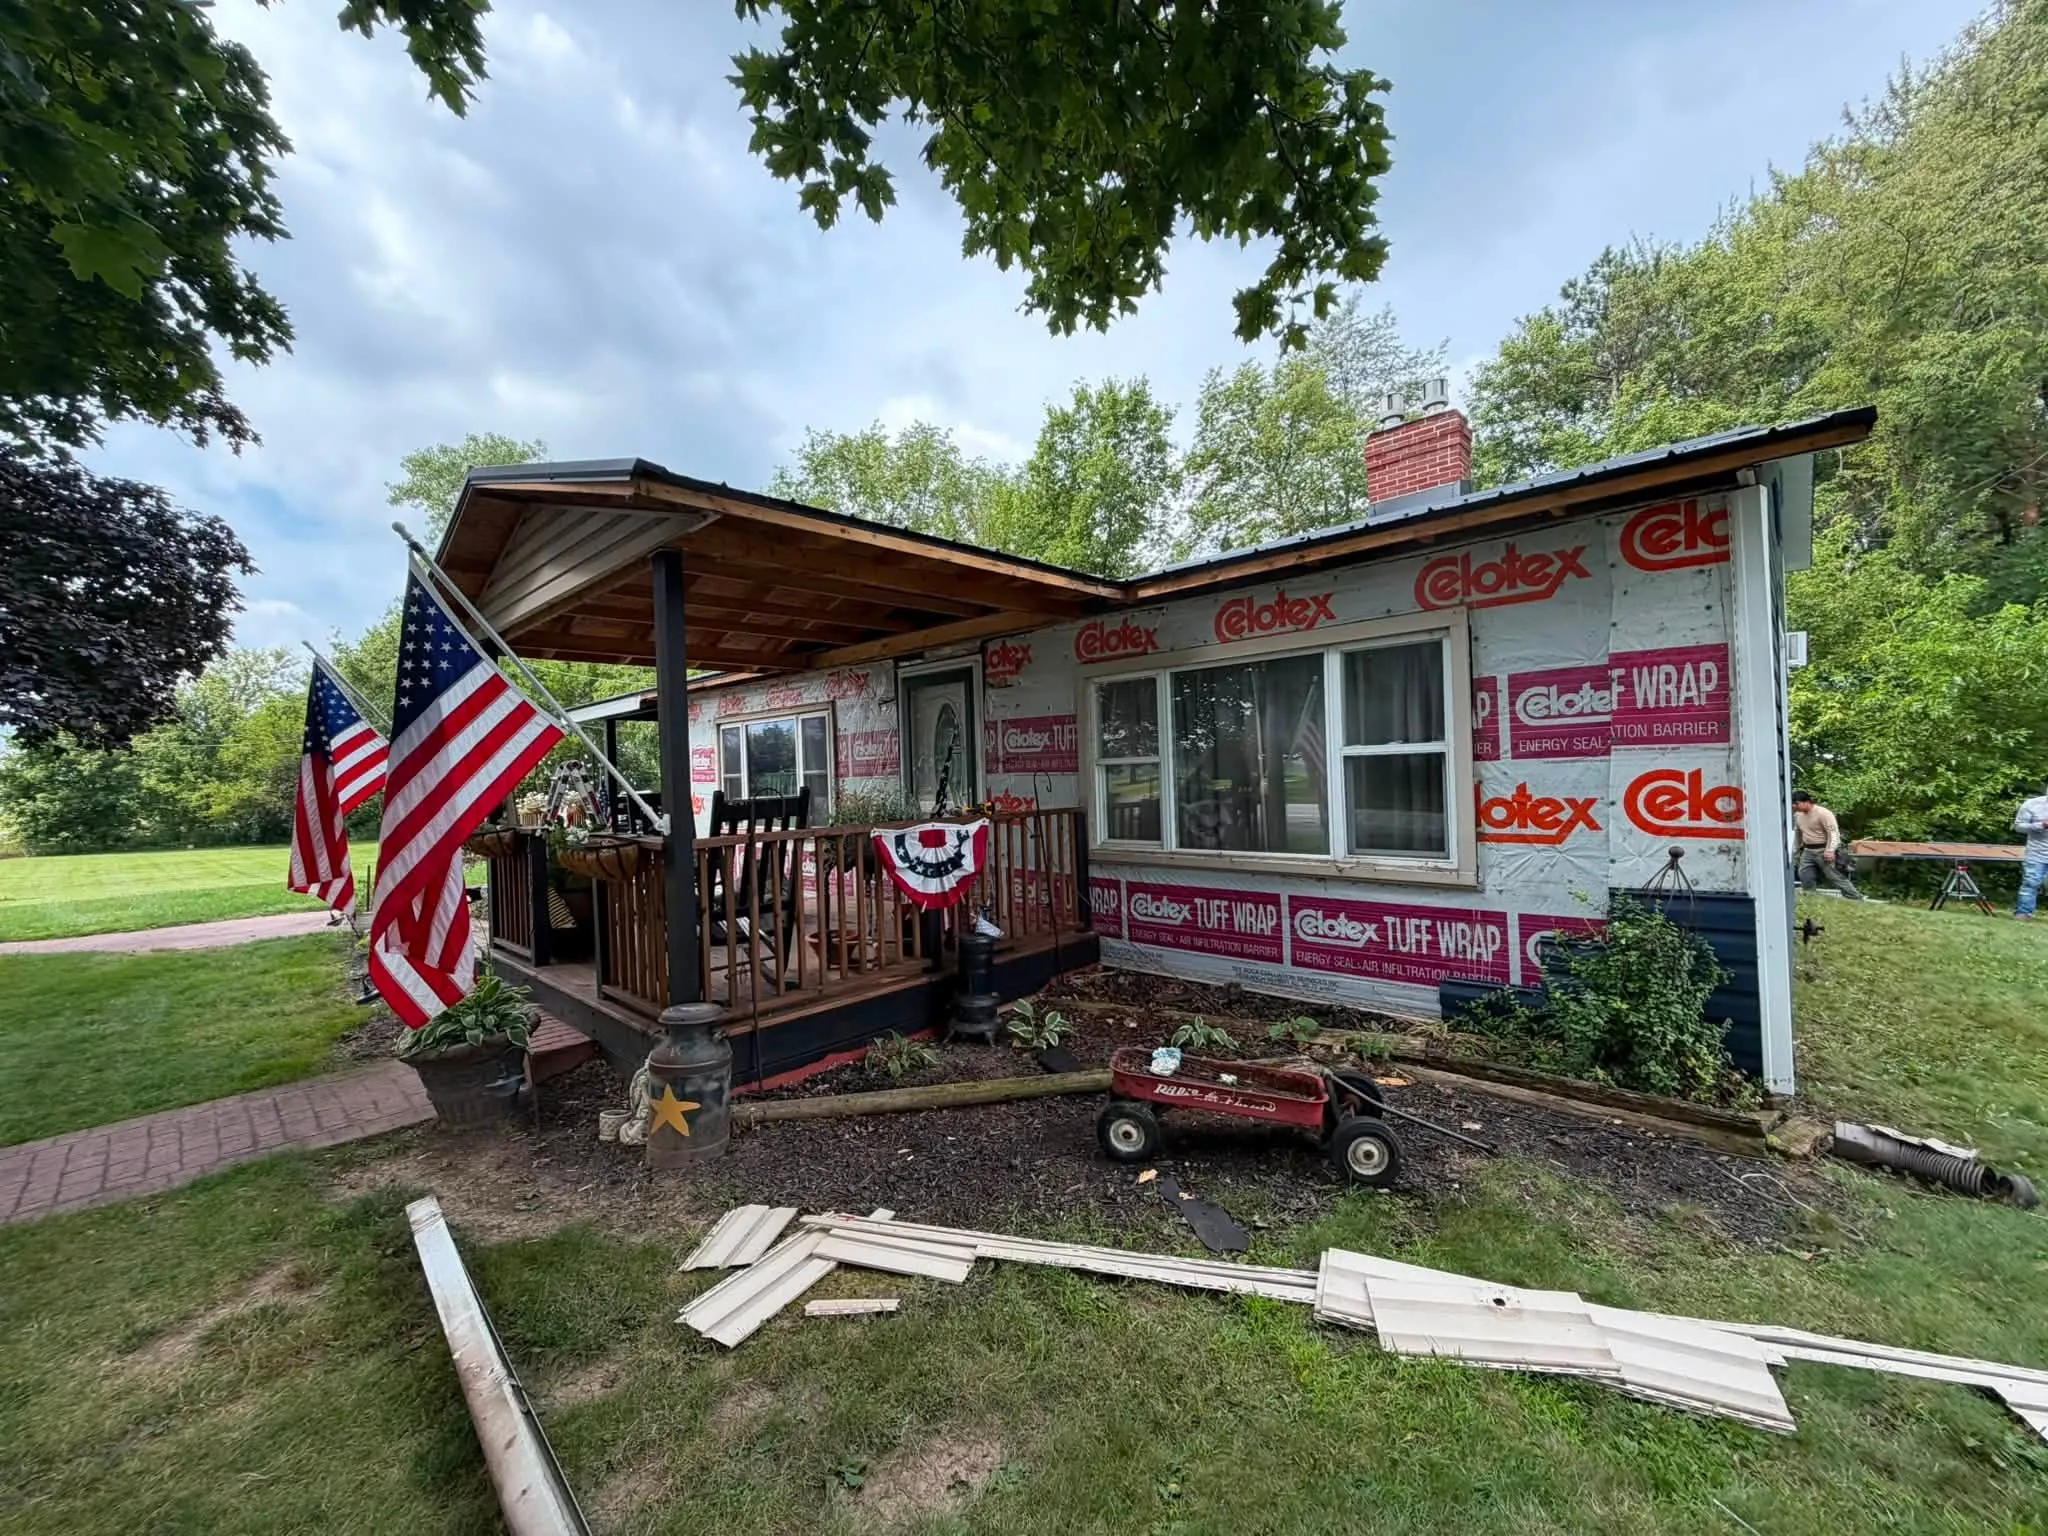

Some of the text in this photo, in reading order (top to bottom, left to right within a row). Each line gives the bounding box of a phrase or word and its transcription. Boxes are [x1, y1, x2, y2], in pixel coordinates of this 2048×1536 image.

[1414, 542, 1592, 610] Celotex
[1074, 616, 1160, 664] Celotex
[1215, 592, 1337, 644] Celotex
[1632, 661, 1719, 710] WRAP
[1004, 726, 1050, 753] Celotex
[1519, 737, 1570, 752] ENERGY
[1573, 736, 1604, 750] SEAL
[1653, 721, 1719, 737] BARRIER
[1130, 892, 1277, 936] Celotex TUFF WRAP
[1294, 908, 1381, 948] Celotex
[1383, 915, 1431, 956] TUFF
[1436, 919, 1501, 962] WRAP
[1243, 942, 1278, 957] BARRIER
[1296, 951, 1331, 966] ENERGY
[1334, 955, 1357, 969] SEAL
[1360, 959, 1379, 973] AIR
[1382, 962, 1448, 981] INFILTRATION
